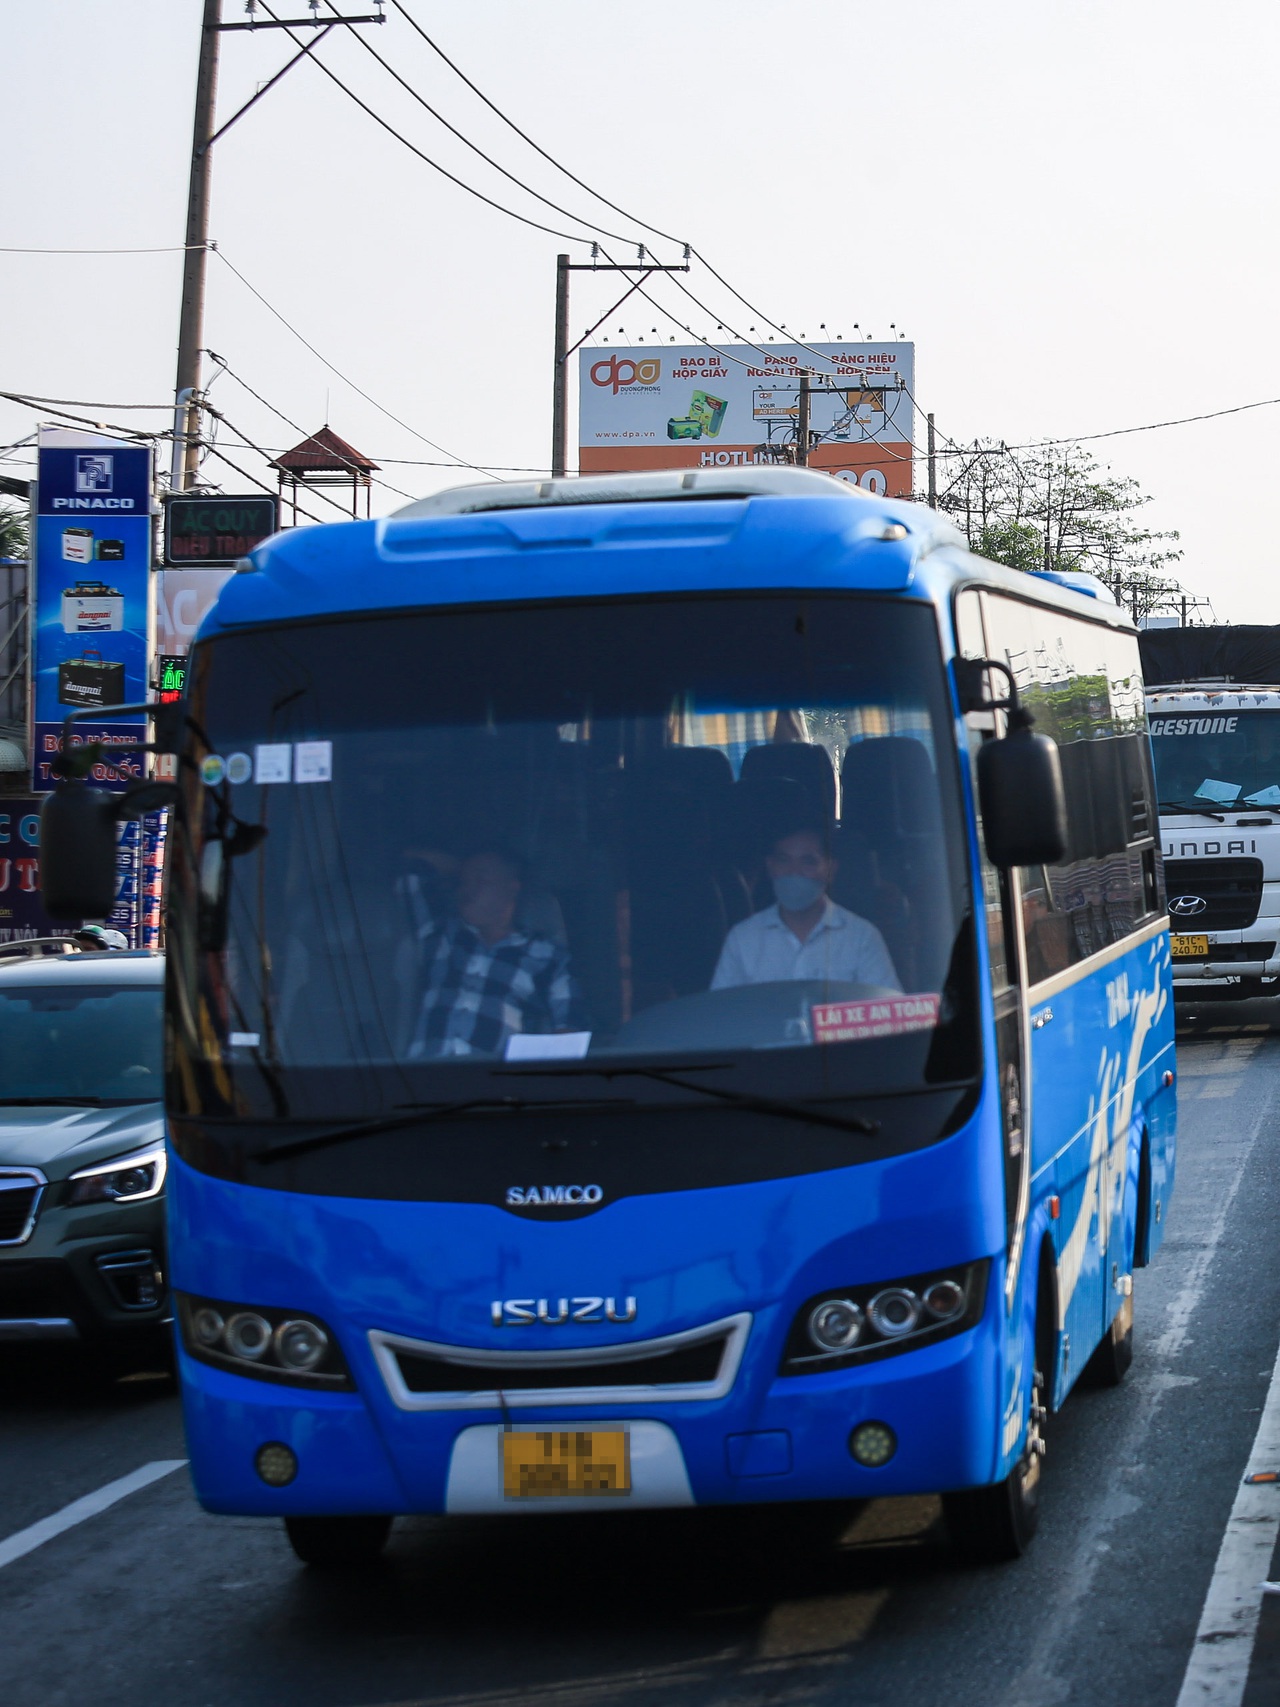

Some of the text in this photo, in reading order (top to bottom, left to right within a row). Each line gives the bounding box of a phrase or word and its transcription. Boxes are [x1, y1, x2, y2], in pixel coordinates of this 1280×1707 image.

[680, 355, 721, 366] BAO BÌ
[764, 357, 798, 365] PANO
[831, 353, 896, 366] BẢNG HIỆU
[672, 366, 729, 380] HỘP GIẤY
[595, 430, 656, 439] www.dpa.vn
[52, 498, 135, 509] PINACO
[1172, 946, 1204, 955] 240.70
[506, 1184, 604, 1205] SAMCO
[490, 1296, 637, 1327] ISUZU
